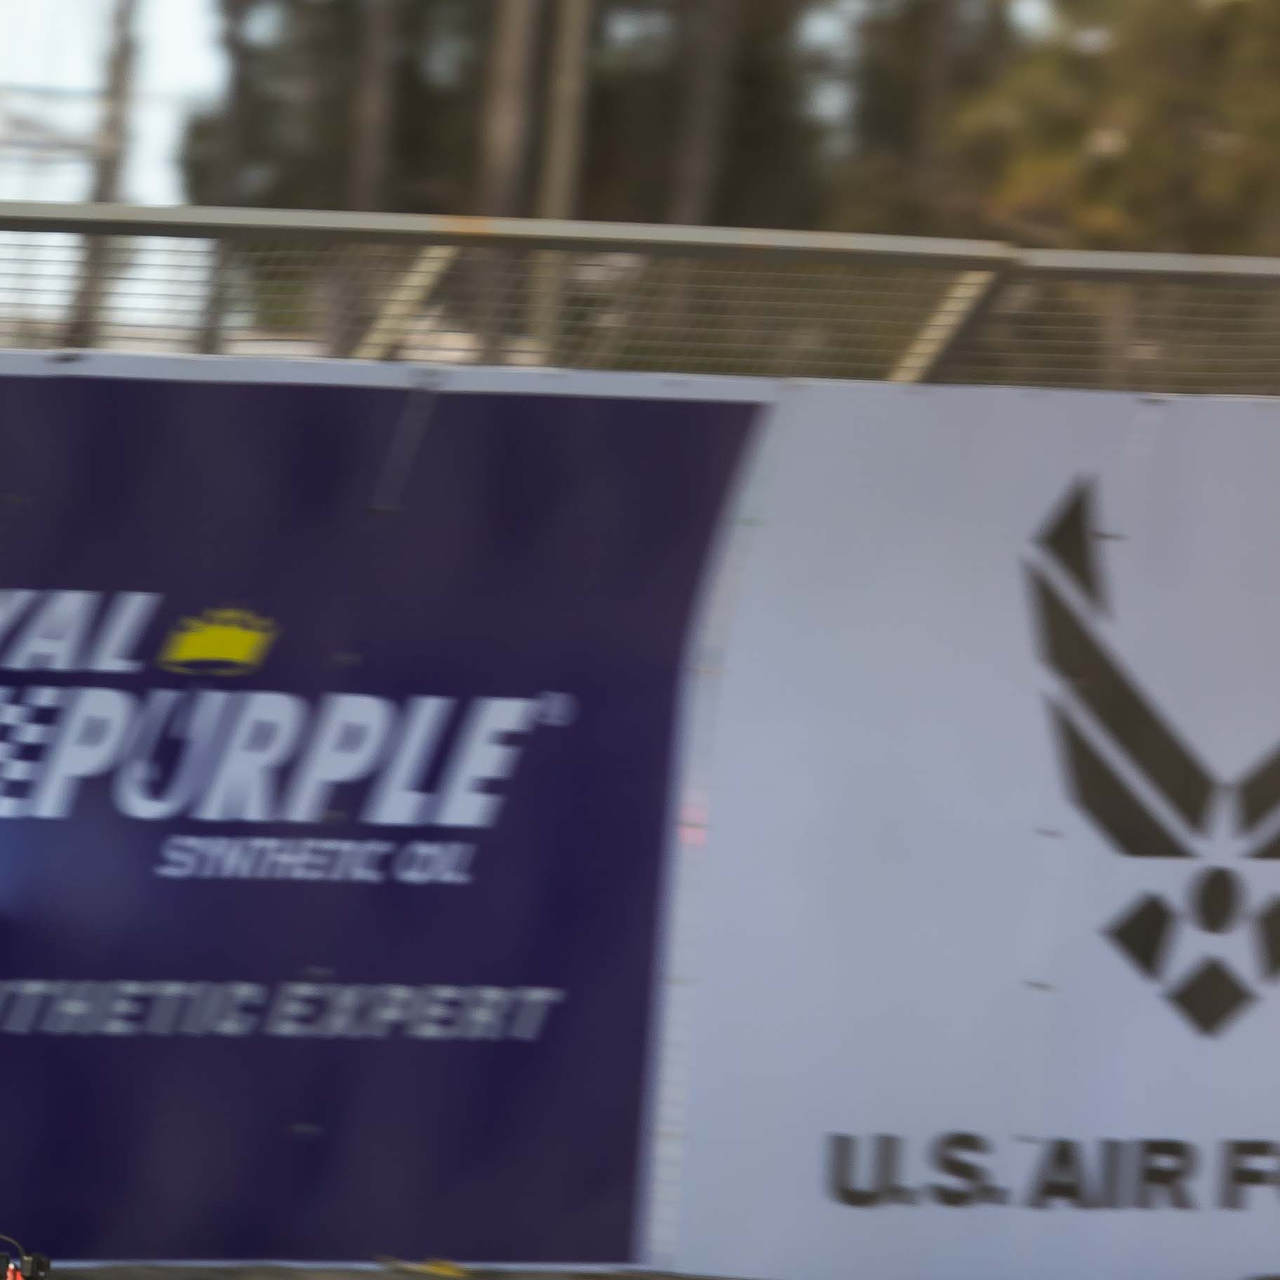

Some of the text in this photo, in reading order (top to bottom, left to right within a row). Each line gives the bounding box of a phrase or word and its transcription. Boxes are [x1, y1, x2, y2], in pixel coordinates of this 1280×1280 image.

[28, 685, 536, 828] PURPLE
[265, 980, 566, 1040] EXPERT
[825, 1132, 1010, 1208] U.S.
[1028, 1138, 1200, 1210] AIR
